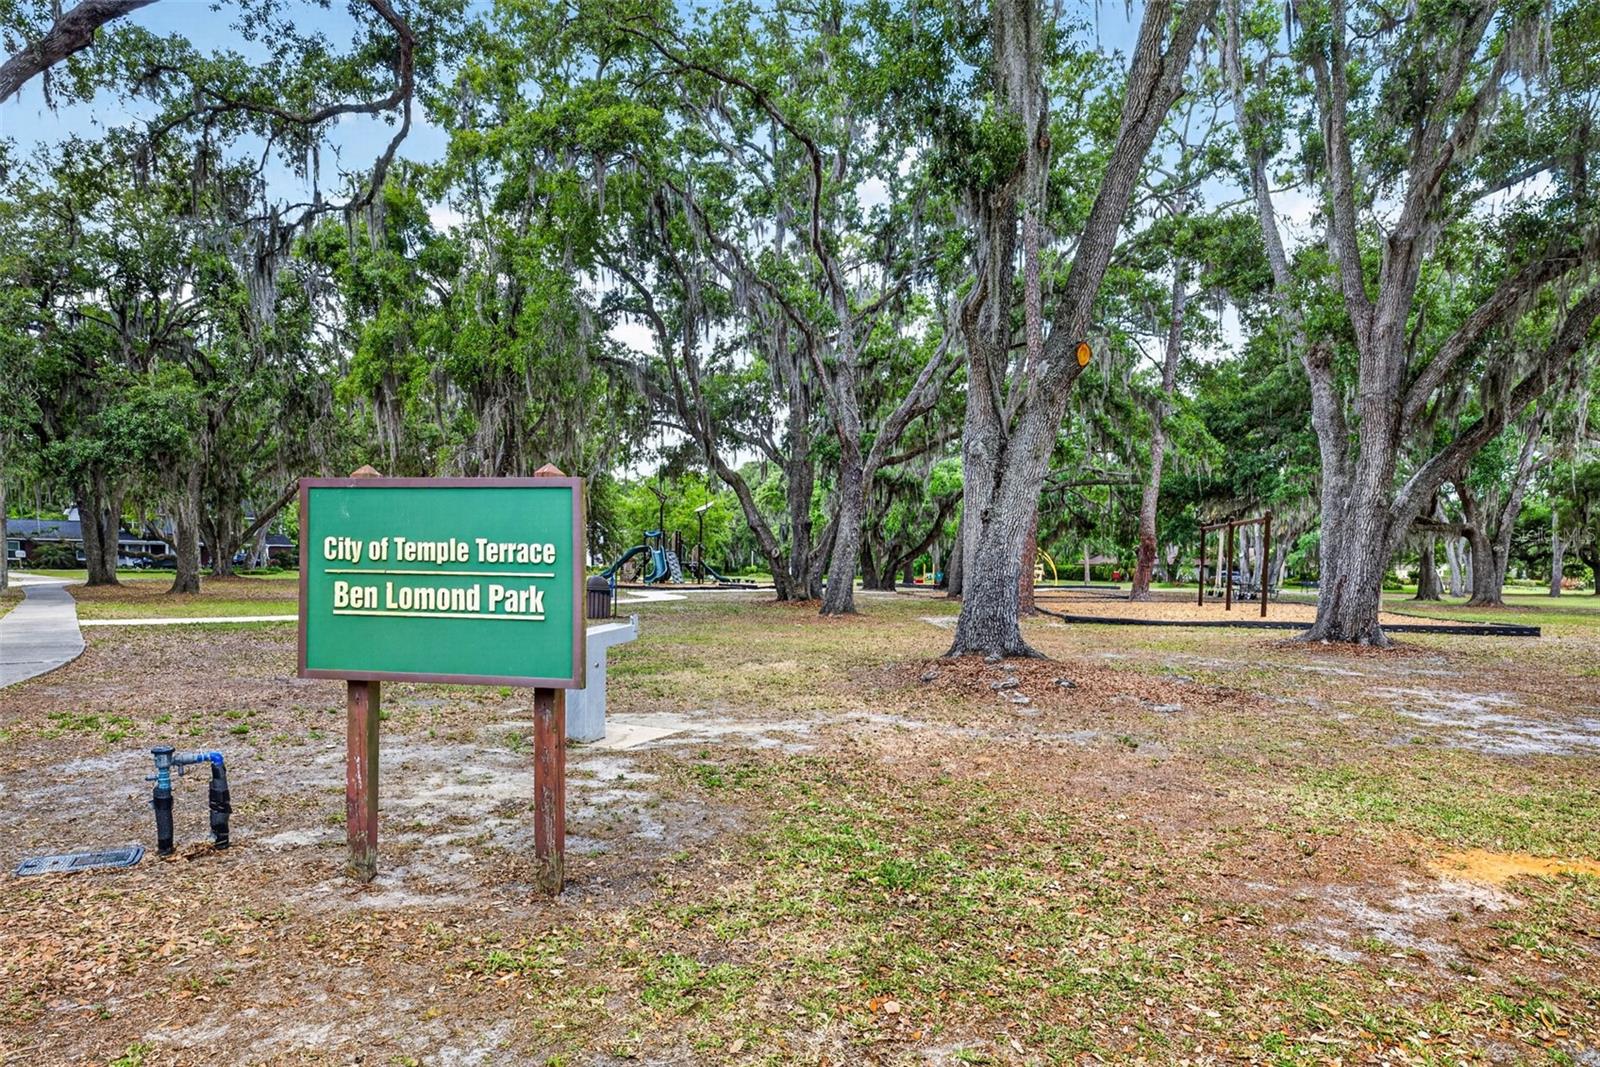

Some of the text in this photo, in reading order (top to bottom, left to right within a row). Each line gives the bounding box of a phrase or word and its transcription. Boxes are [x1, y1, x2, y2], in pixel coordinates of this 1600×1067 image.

[323, 536, 556, 564] City of Temple Terrace
[333, 581, 545, 613] Ben Lomond Park
